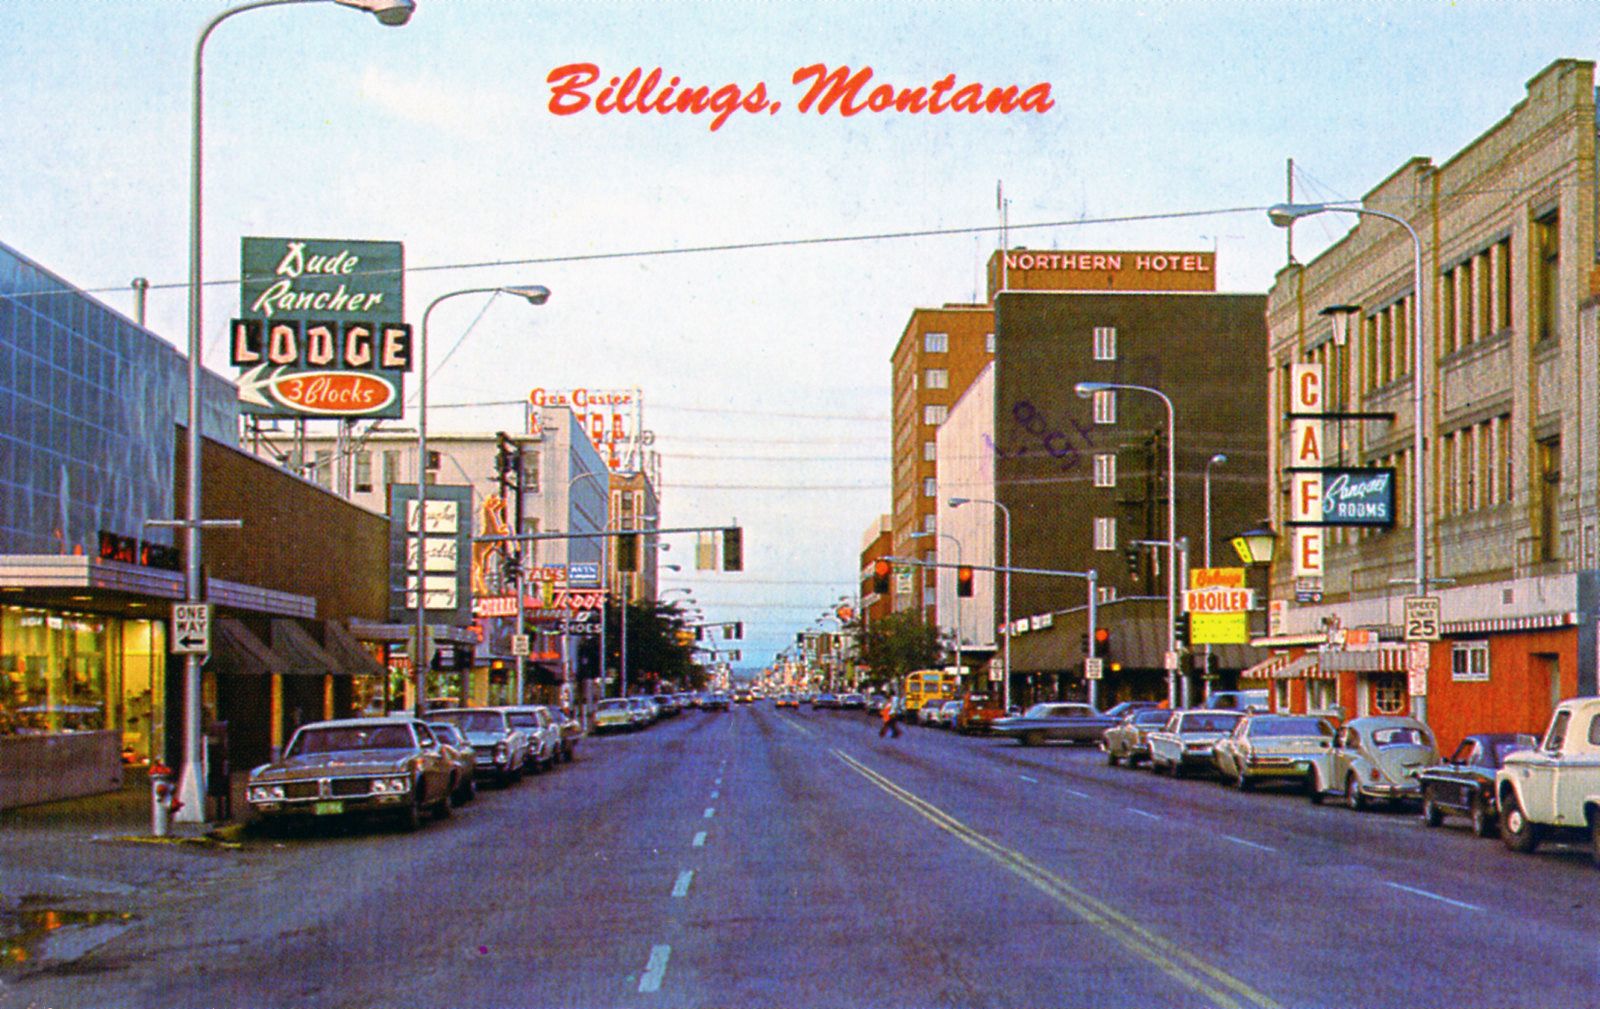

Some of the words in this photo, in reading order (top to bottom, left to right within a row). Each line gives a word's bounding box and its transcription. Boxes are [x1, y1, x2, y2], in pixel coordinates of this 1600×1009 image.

[276, 242, 358, 277] Dude
[1005, 254, 1121, 271] NORTHERN
[1136, 255, 1209, 271] HOTEL
[252, 279, 383, 317] Rancher
[235, 324, 406, 367] LODGE
[288, 379, 304, 401] 3
[305, 377, 374, 404] Blocks
[572, 388, 631, 407] Custer
[1300, 372, 1319, 569] CAFE
[1339, 503, 1386, 517] ROOMS
[1187, 591, 1249, 611] BROILER
[1408, 601, 1438, 609] SPEED
[177, 606, 206, 620] ONE
[177, 620, 207, 634] WAY
[1409, 620, 1436, 636] 25
